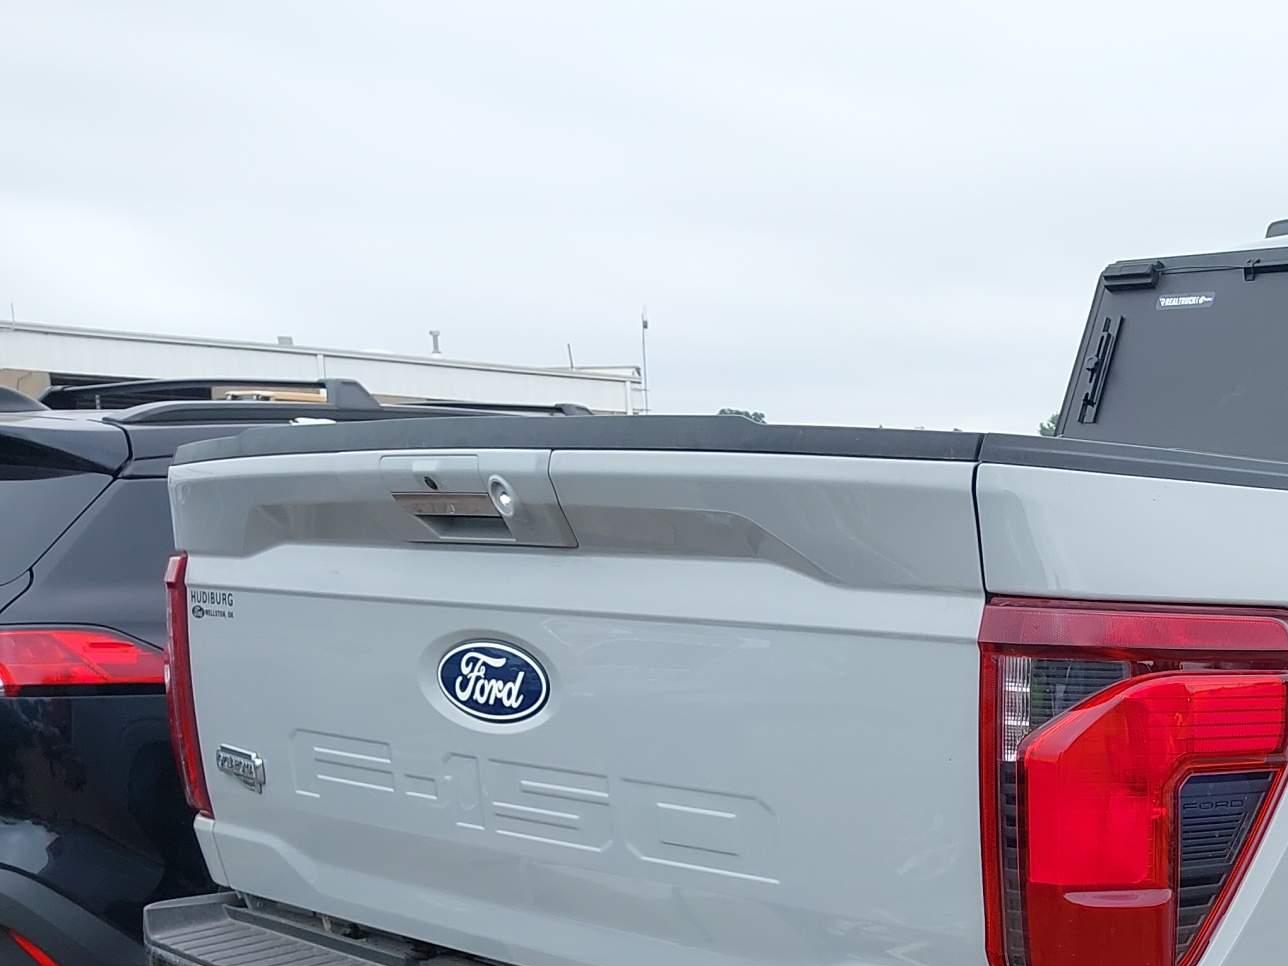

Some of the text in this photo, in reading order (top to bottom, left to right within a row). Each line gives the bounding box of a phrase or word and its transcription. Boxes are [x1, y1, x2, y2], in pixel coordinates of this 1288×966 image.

[191, 590, 233, 606] HUDIBURG
[454, 650, 525, 709] Ford
[288, 728, 780, 886] F-150
[1182, 800, 1245, 810] FORD
